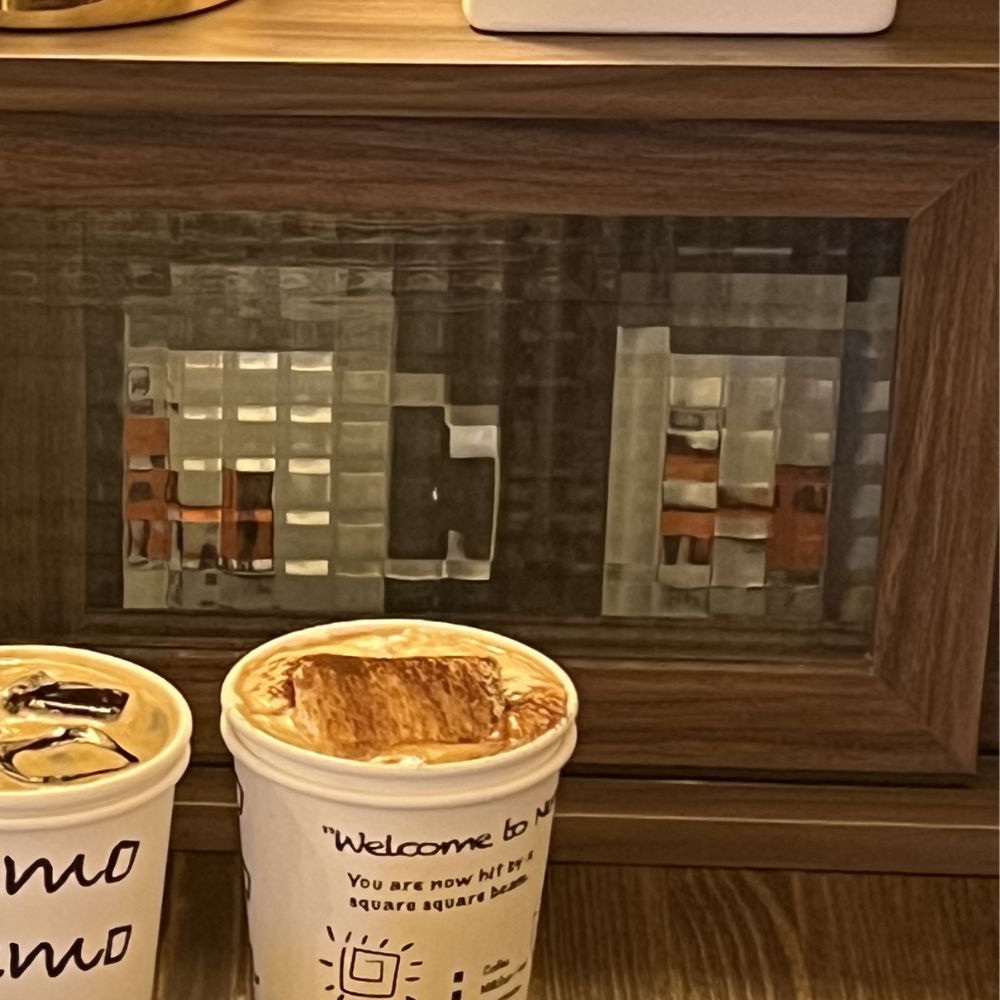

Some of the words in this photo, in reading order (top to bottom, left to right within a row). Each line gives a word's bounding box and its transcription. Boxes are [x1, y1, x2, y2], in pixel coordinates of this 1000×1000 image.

[503, 817, 529, 842] to
[347, 872, 383, 891] You
[389, 881, 424, 891] are
[430, 874, 473, 891] now
[479, 863, 503, 882] hit
[349, 897, 416, 912] square
[423, 891, 485, 912] square
